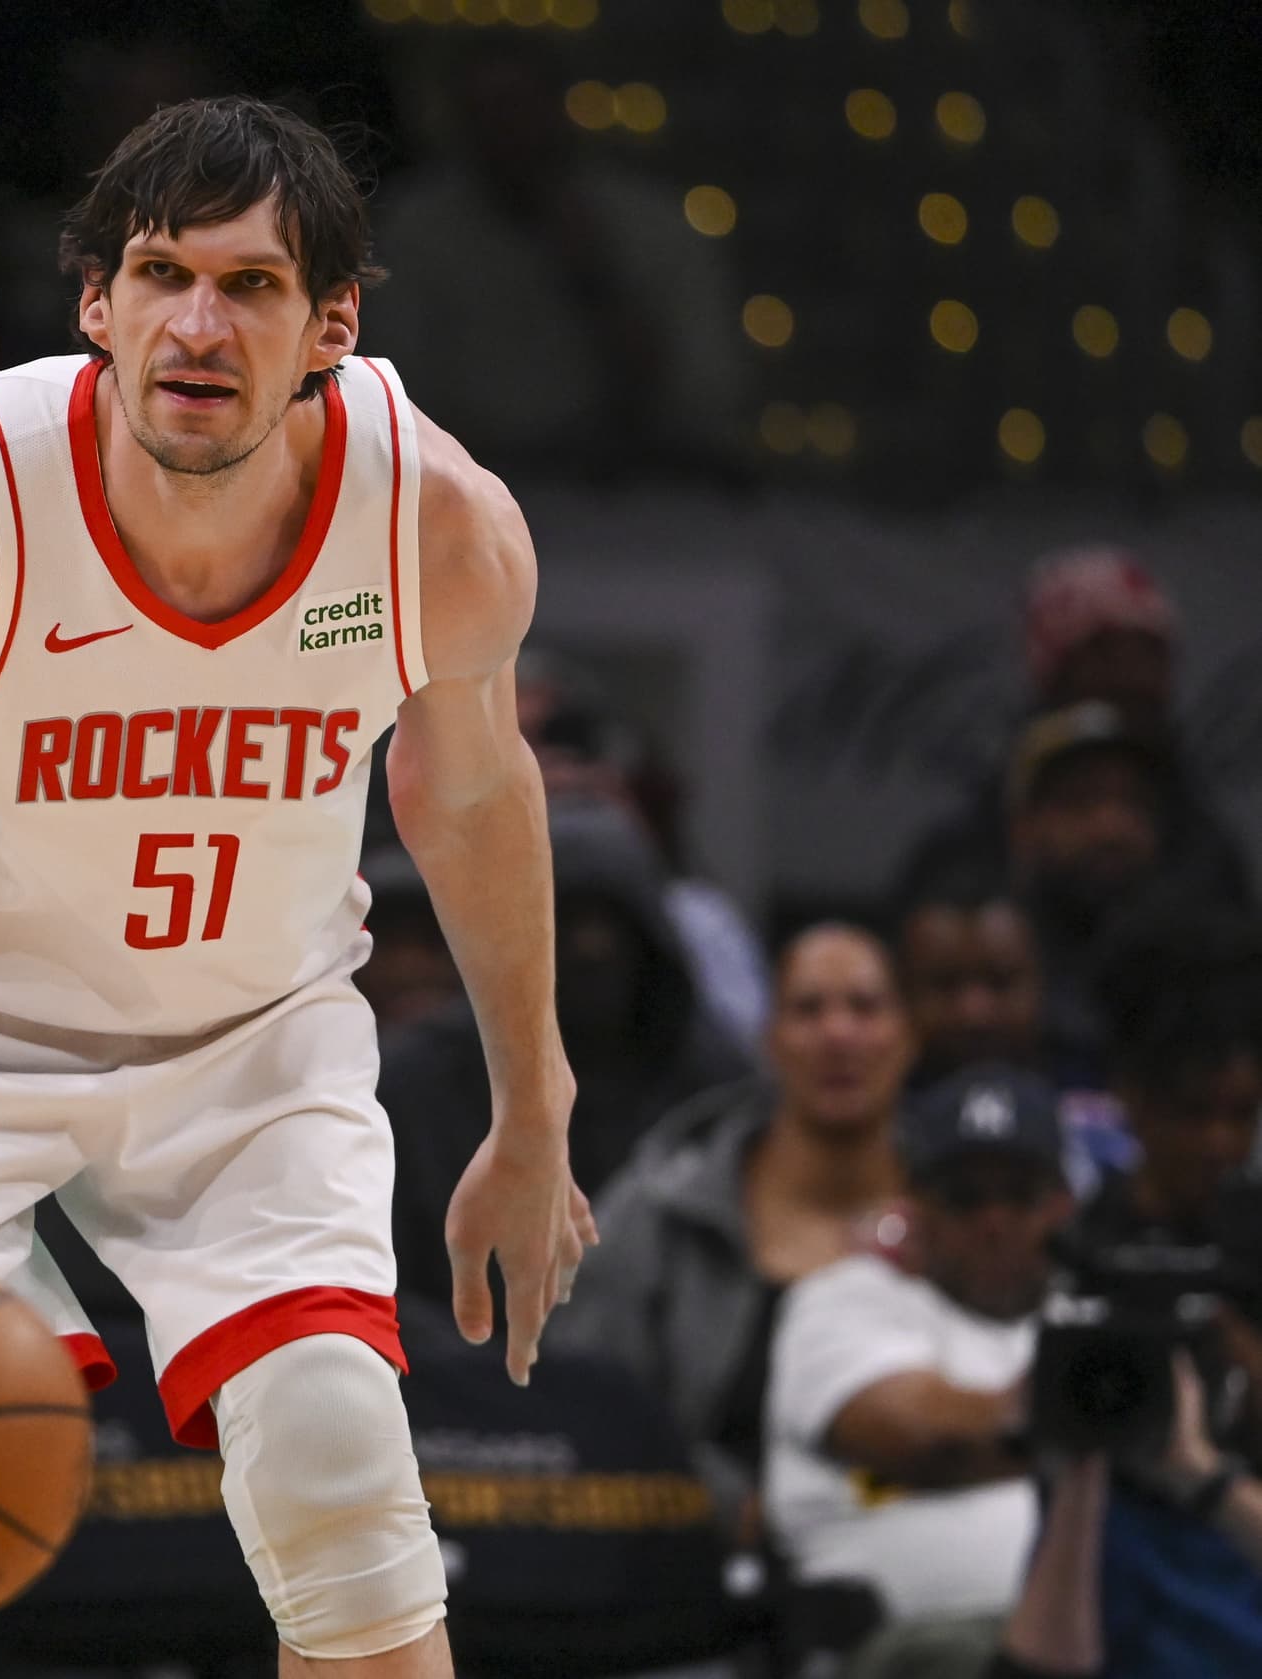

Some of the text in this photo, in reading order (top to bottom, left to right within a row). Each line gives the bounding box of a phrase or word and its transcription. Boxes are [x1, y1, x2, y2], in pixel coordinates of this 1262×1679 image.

[300, 622, 383, 652] karma
[304, 592, 383, 625] credit
[15, 706, 360, 803] ROCKETS
[125, 833, 240, 950] 51
